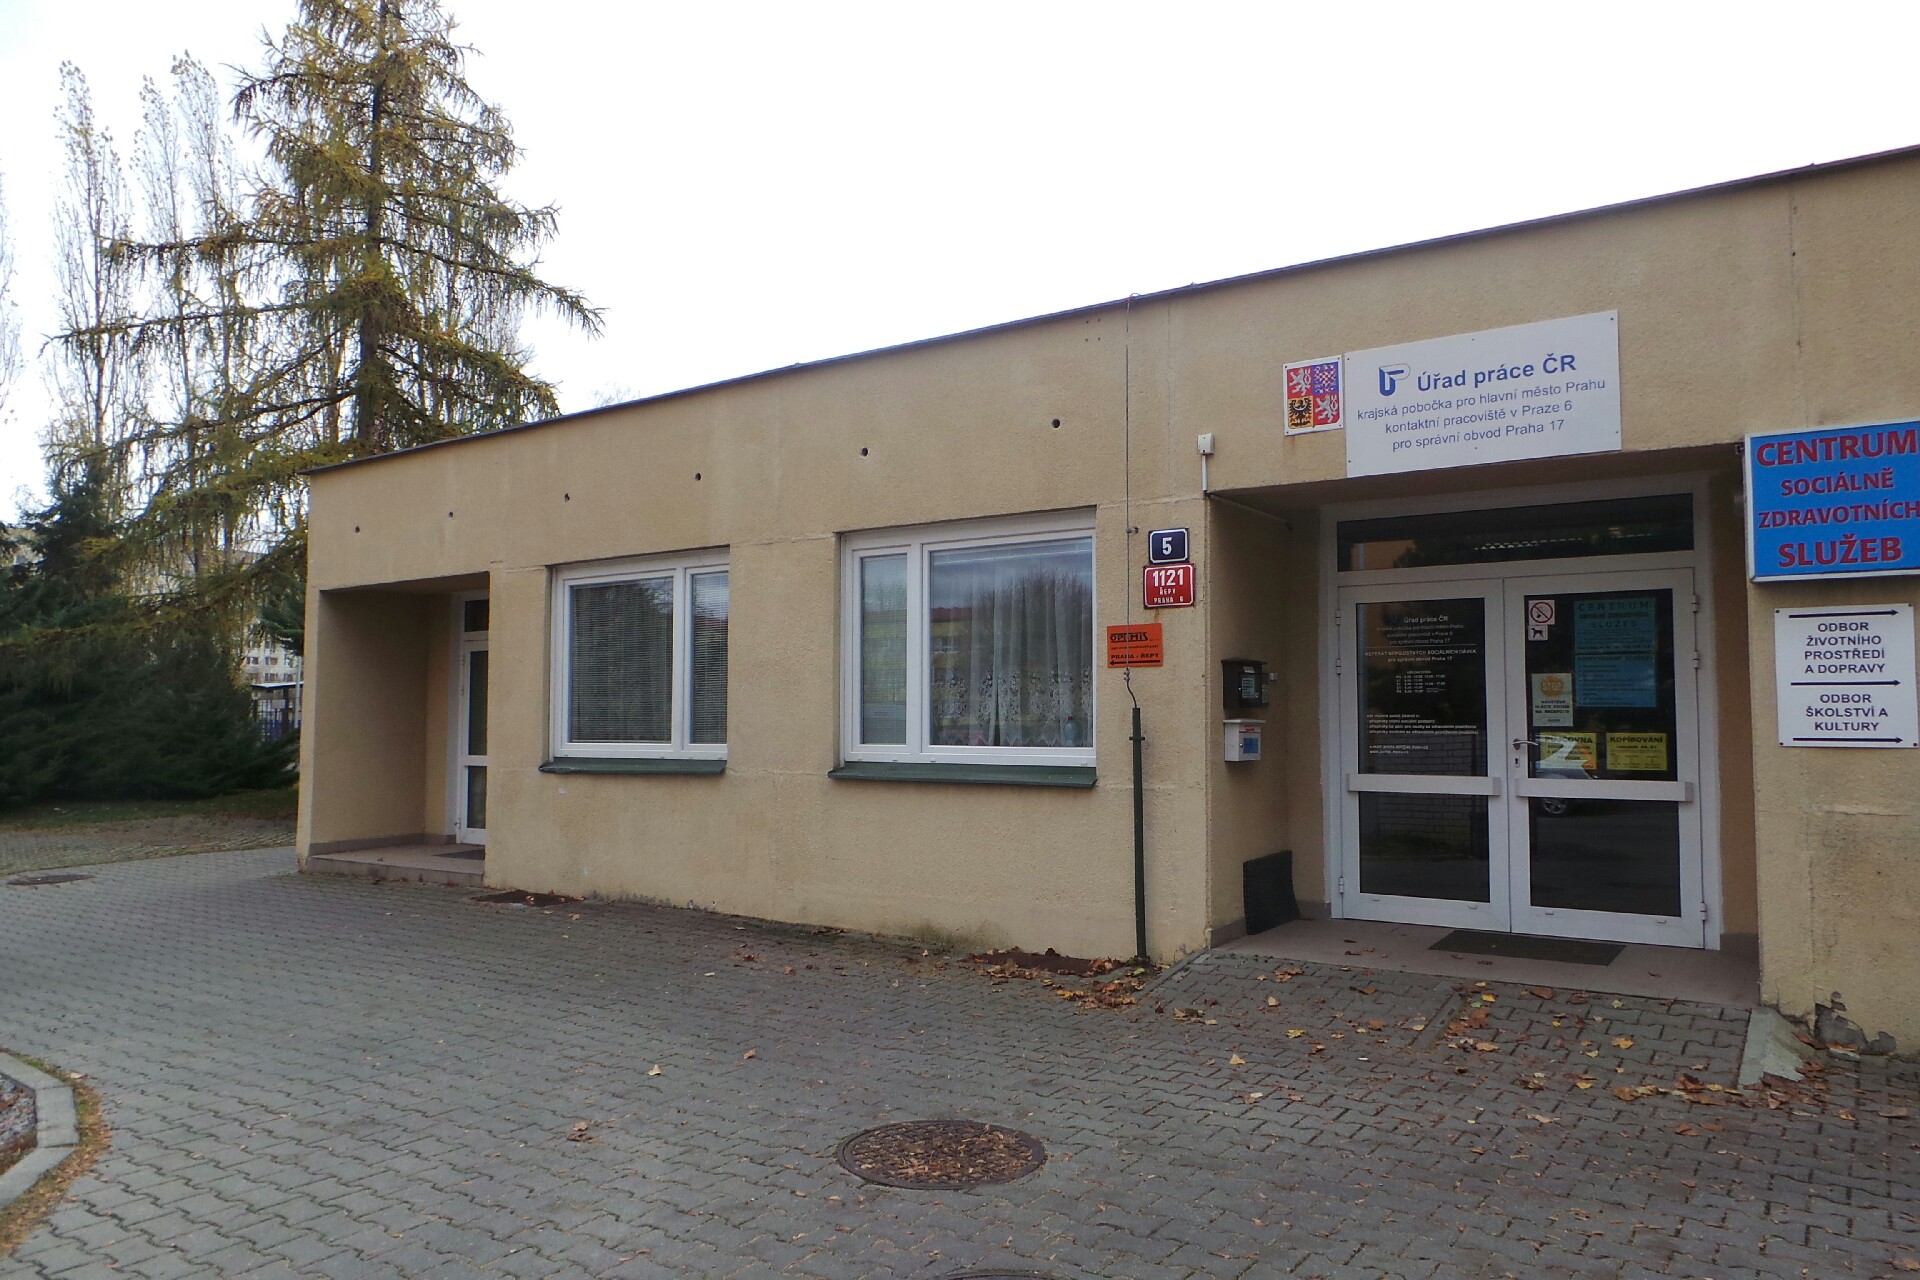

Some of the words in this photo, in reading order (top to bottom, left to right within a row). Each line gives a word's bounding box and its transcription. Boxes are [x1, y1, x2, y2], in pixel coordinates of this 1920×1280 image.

[1417, 368, 1466, 392] Úřad
[1474, 362, 1534, 388] práce
[1542, 352, 1577, 374] ČR
[1358, 405, 1398, 420] krajská
[1402, 398, 1452, 418] pobočka
[1456, 396, 1476, 410] pro
[1479, 388, 1518, 404] hlavní
[1521, 384, 1561, 399] město
[1566, 378, 1606, 394] Prahu
[1386, 416, 1440, 434] kontaktní
[1444, 408, 1506, 430] pracoviště
[1511, 408, 1518, 418] v
[1522, 402, 1560, 417] Praze
[1564, 400, 1573, 412] 6
[1392, 438, 1412, 452] pro
[1416, 431, 1460, 448] správní
[1464, 427, 1502, 442] obvod
[1506, 422, 1544, 436] Praha
[1550, 420, 1564, 432] 17
[1756, 428, 1918, 467] CENTRUM
[1781, 467, 1894, 496] SOCIÁLNĚ
[1758, 498, 1920, 528] ZDRAVOTNÍCH
[1162, 536, 1172, 555] 5
[1778, 533, 1902, 568] SLUŽEB
[1152, 568, 1184, 587] 1121
[1160, 586, 1176, 596] ŘEPY
[1818, 622, 1869, 632] ODBOR
[1806, 634, 1882, 646] ŽIVOTNÍHO
[1804, 648, 1885, 660] PROSTŘEDÍ
[1805, 664, 1814, 674] A
[1818, 664, 1886, 674] DOPRAVY
[1820, 694, 1871, 704] ODBOR
[1806, 706, 1874, 717] ŠKOLSTVÍ
[1878, 708, 1888, 717] A
[1814, 722, 1879, 731] KULTURY
